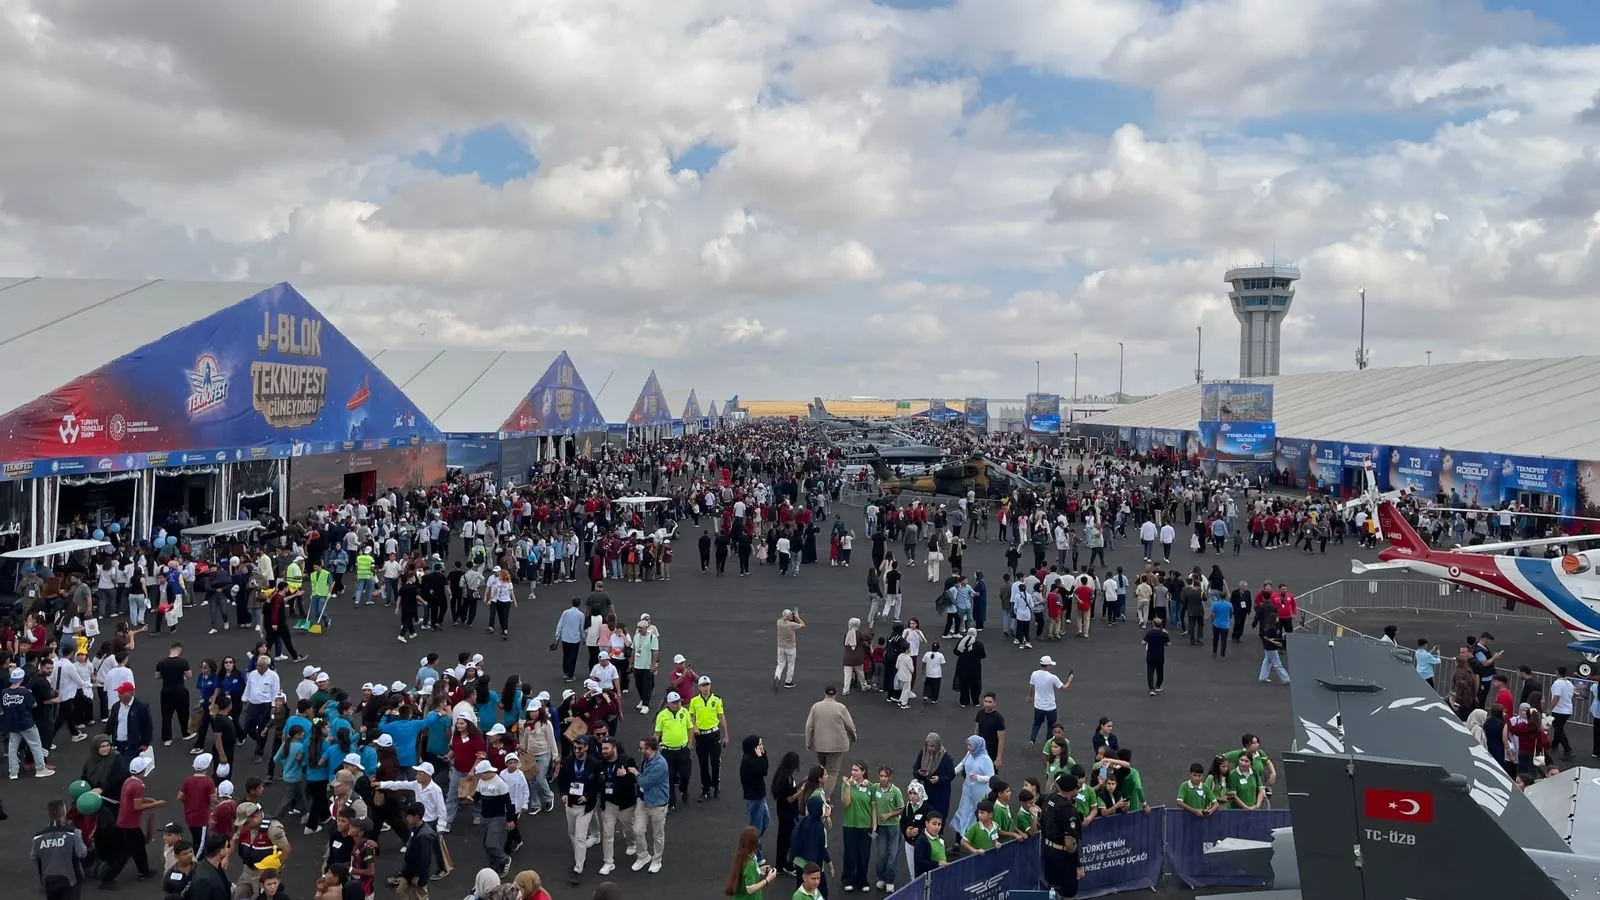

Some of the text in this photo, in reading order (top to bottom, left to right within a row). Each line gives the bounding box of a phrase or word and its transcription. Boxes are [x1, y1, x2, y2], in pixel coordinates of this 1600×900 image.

[257, 311, 322, 357] J-BLOK
[251, 362, 328, 396] TEKNOFEST
[188, 382, 228, 413] TEKNOFEST
[268, 397, 318, 417] GÜNEYDOĞU
[1325, 449, 1333, 459] T3
[1409, 457, 1421, 468] T3
[1516, 465, 1549, 474] TEKNOFEST
[39, 837, 65, 849] AFAD
[1082, 838, 1126, 854] TÜRKİYE'NİN
[1364, 828, 1416, 846] TC-ÖZB
[1102, 857, 1126, 869] SAVAŞ
[1126, 851, 1149, 865] UÇAĞI
